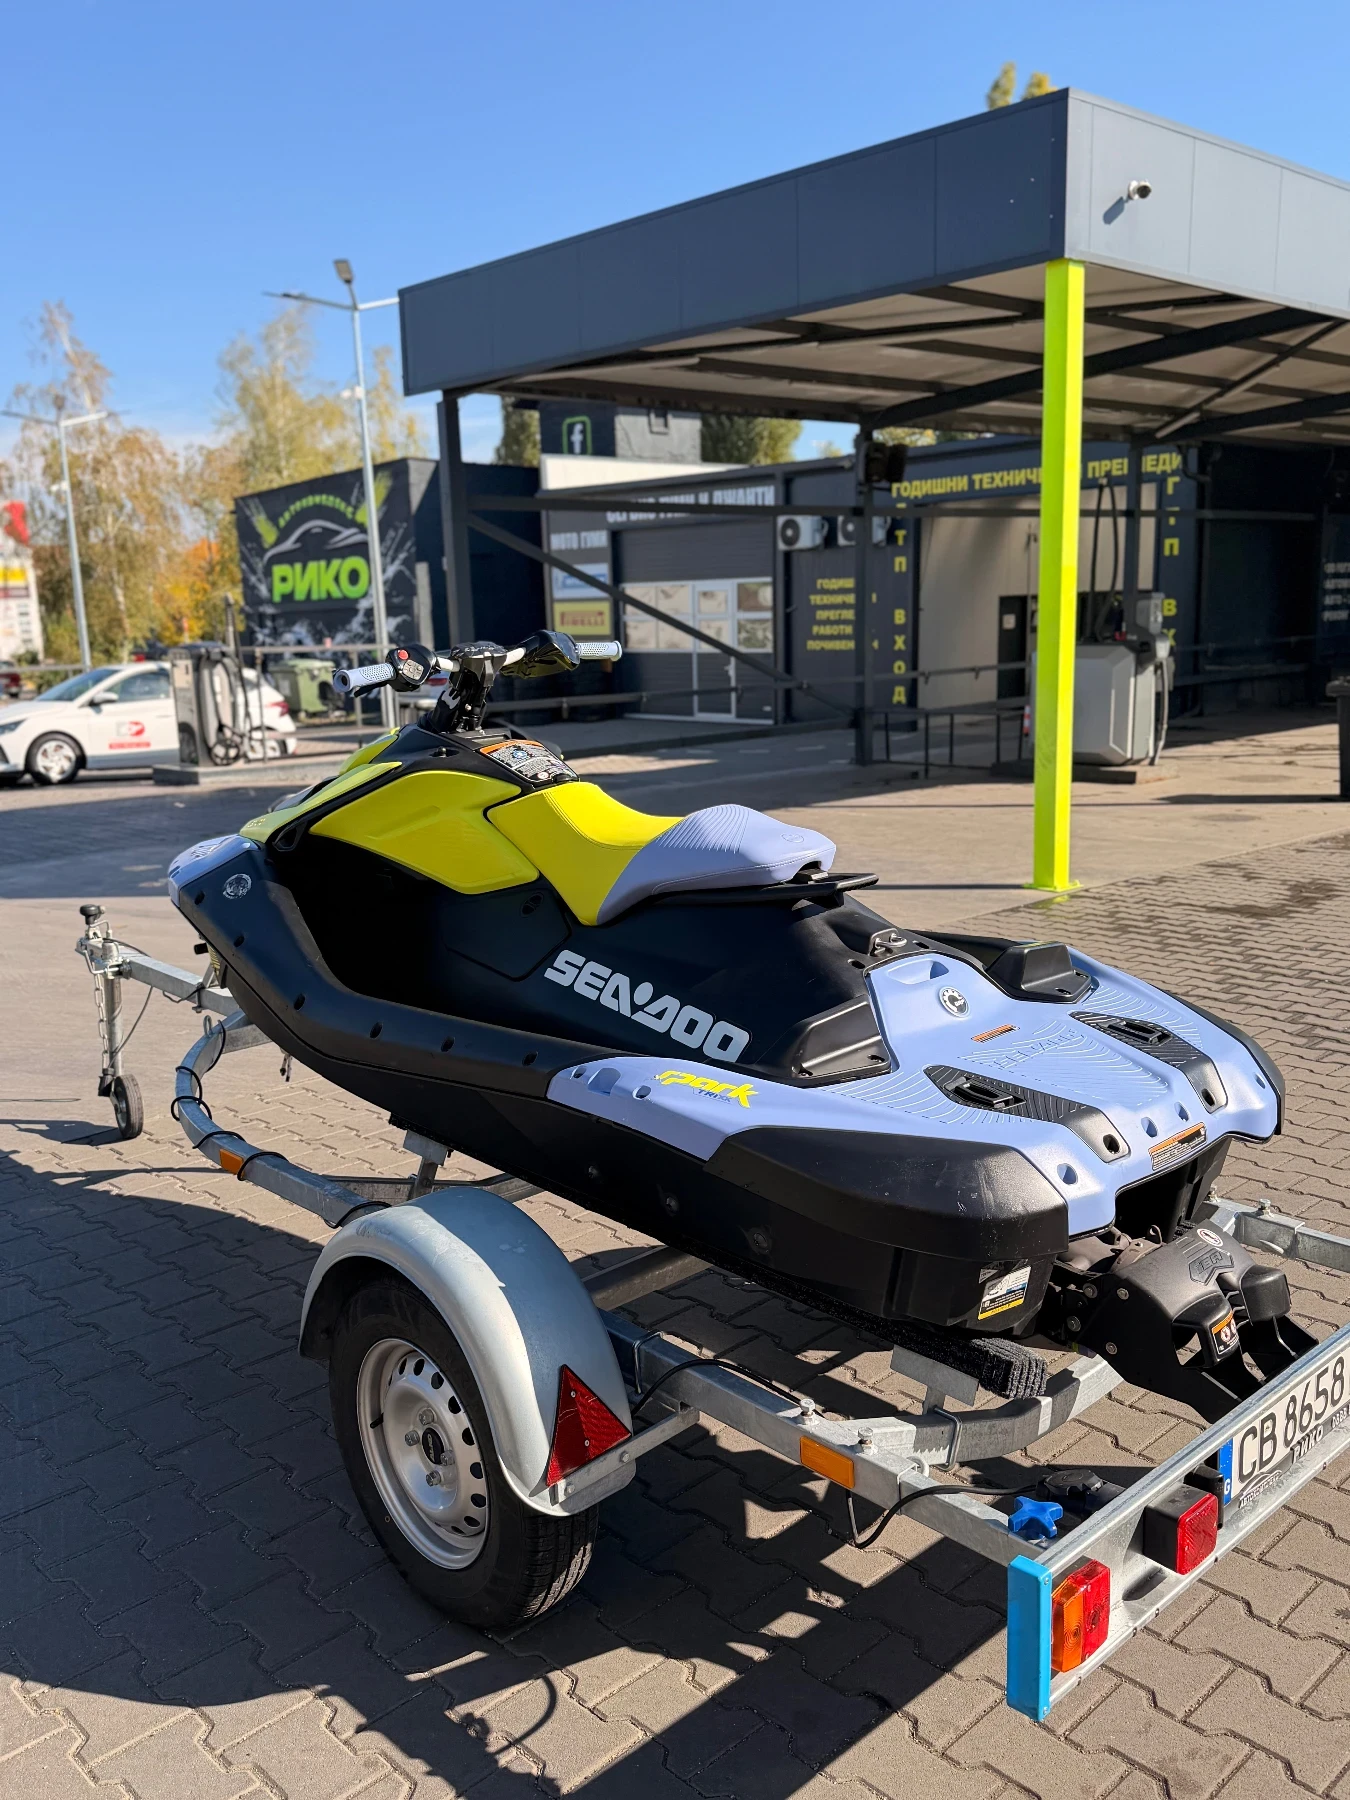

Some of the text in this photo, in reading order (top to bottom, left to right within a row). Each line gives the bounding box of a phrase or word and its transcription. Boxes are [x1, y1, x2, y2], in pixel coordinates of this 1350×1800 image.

[891, 475, 968, 498] ГОДИШНИ
[1087, 453, 1182, 479] ПРЕЕДИ
[272, 556, 370, 603] РИКО
[816, 577, 855, 590] ГОДИШ
[815, 608, 856, 621] ПРЕГЛЕ
[892, 608, 907, 705] ВХОД
[1283, 1356, 1345, 1448] 8658
